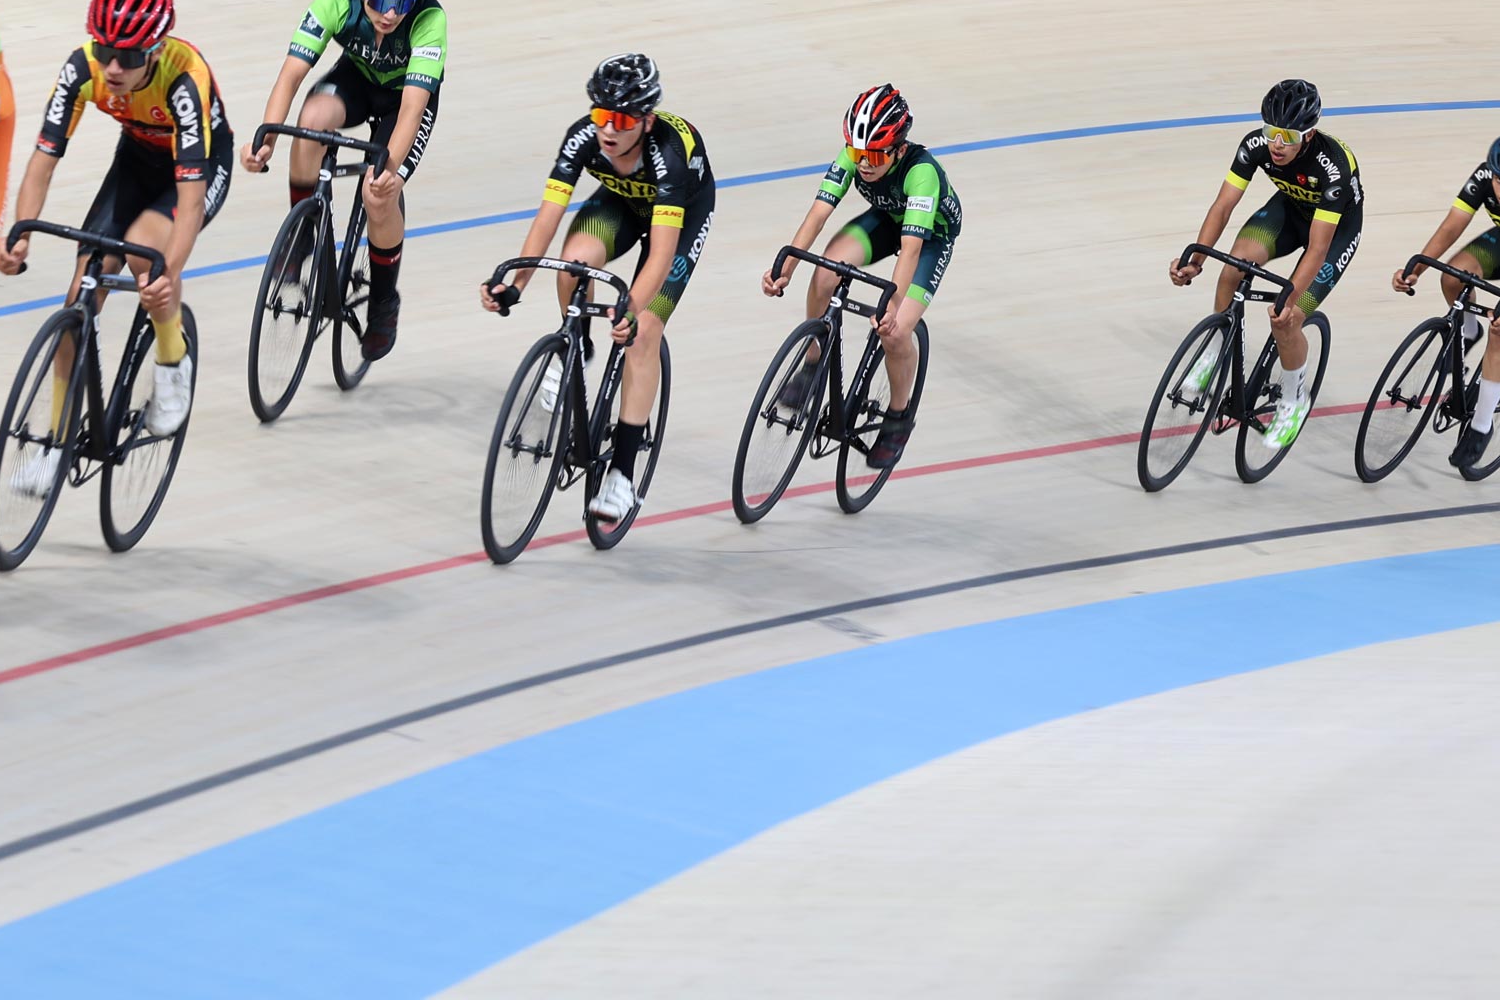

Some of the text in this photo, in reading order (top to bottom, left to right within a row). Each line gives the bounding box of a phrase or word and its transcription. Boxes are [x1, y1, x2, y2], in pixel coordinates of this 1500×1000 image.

[46, 63, 78, 125] KONYA
[406, 73, 432, 86] MERAM
[171, 84, 200, 150] KONYA
[408, 108, 433, 167] MERAM
[1246, 136, 1267, 150] KON
[1316, 152, 1341, 183] KONYA
